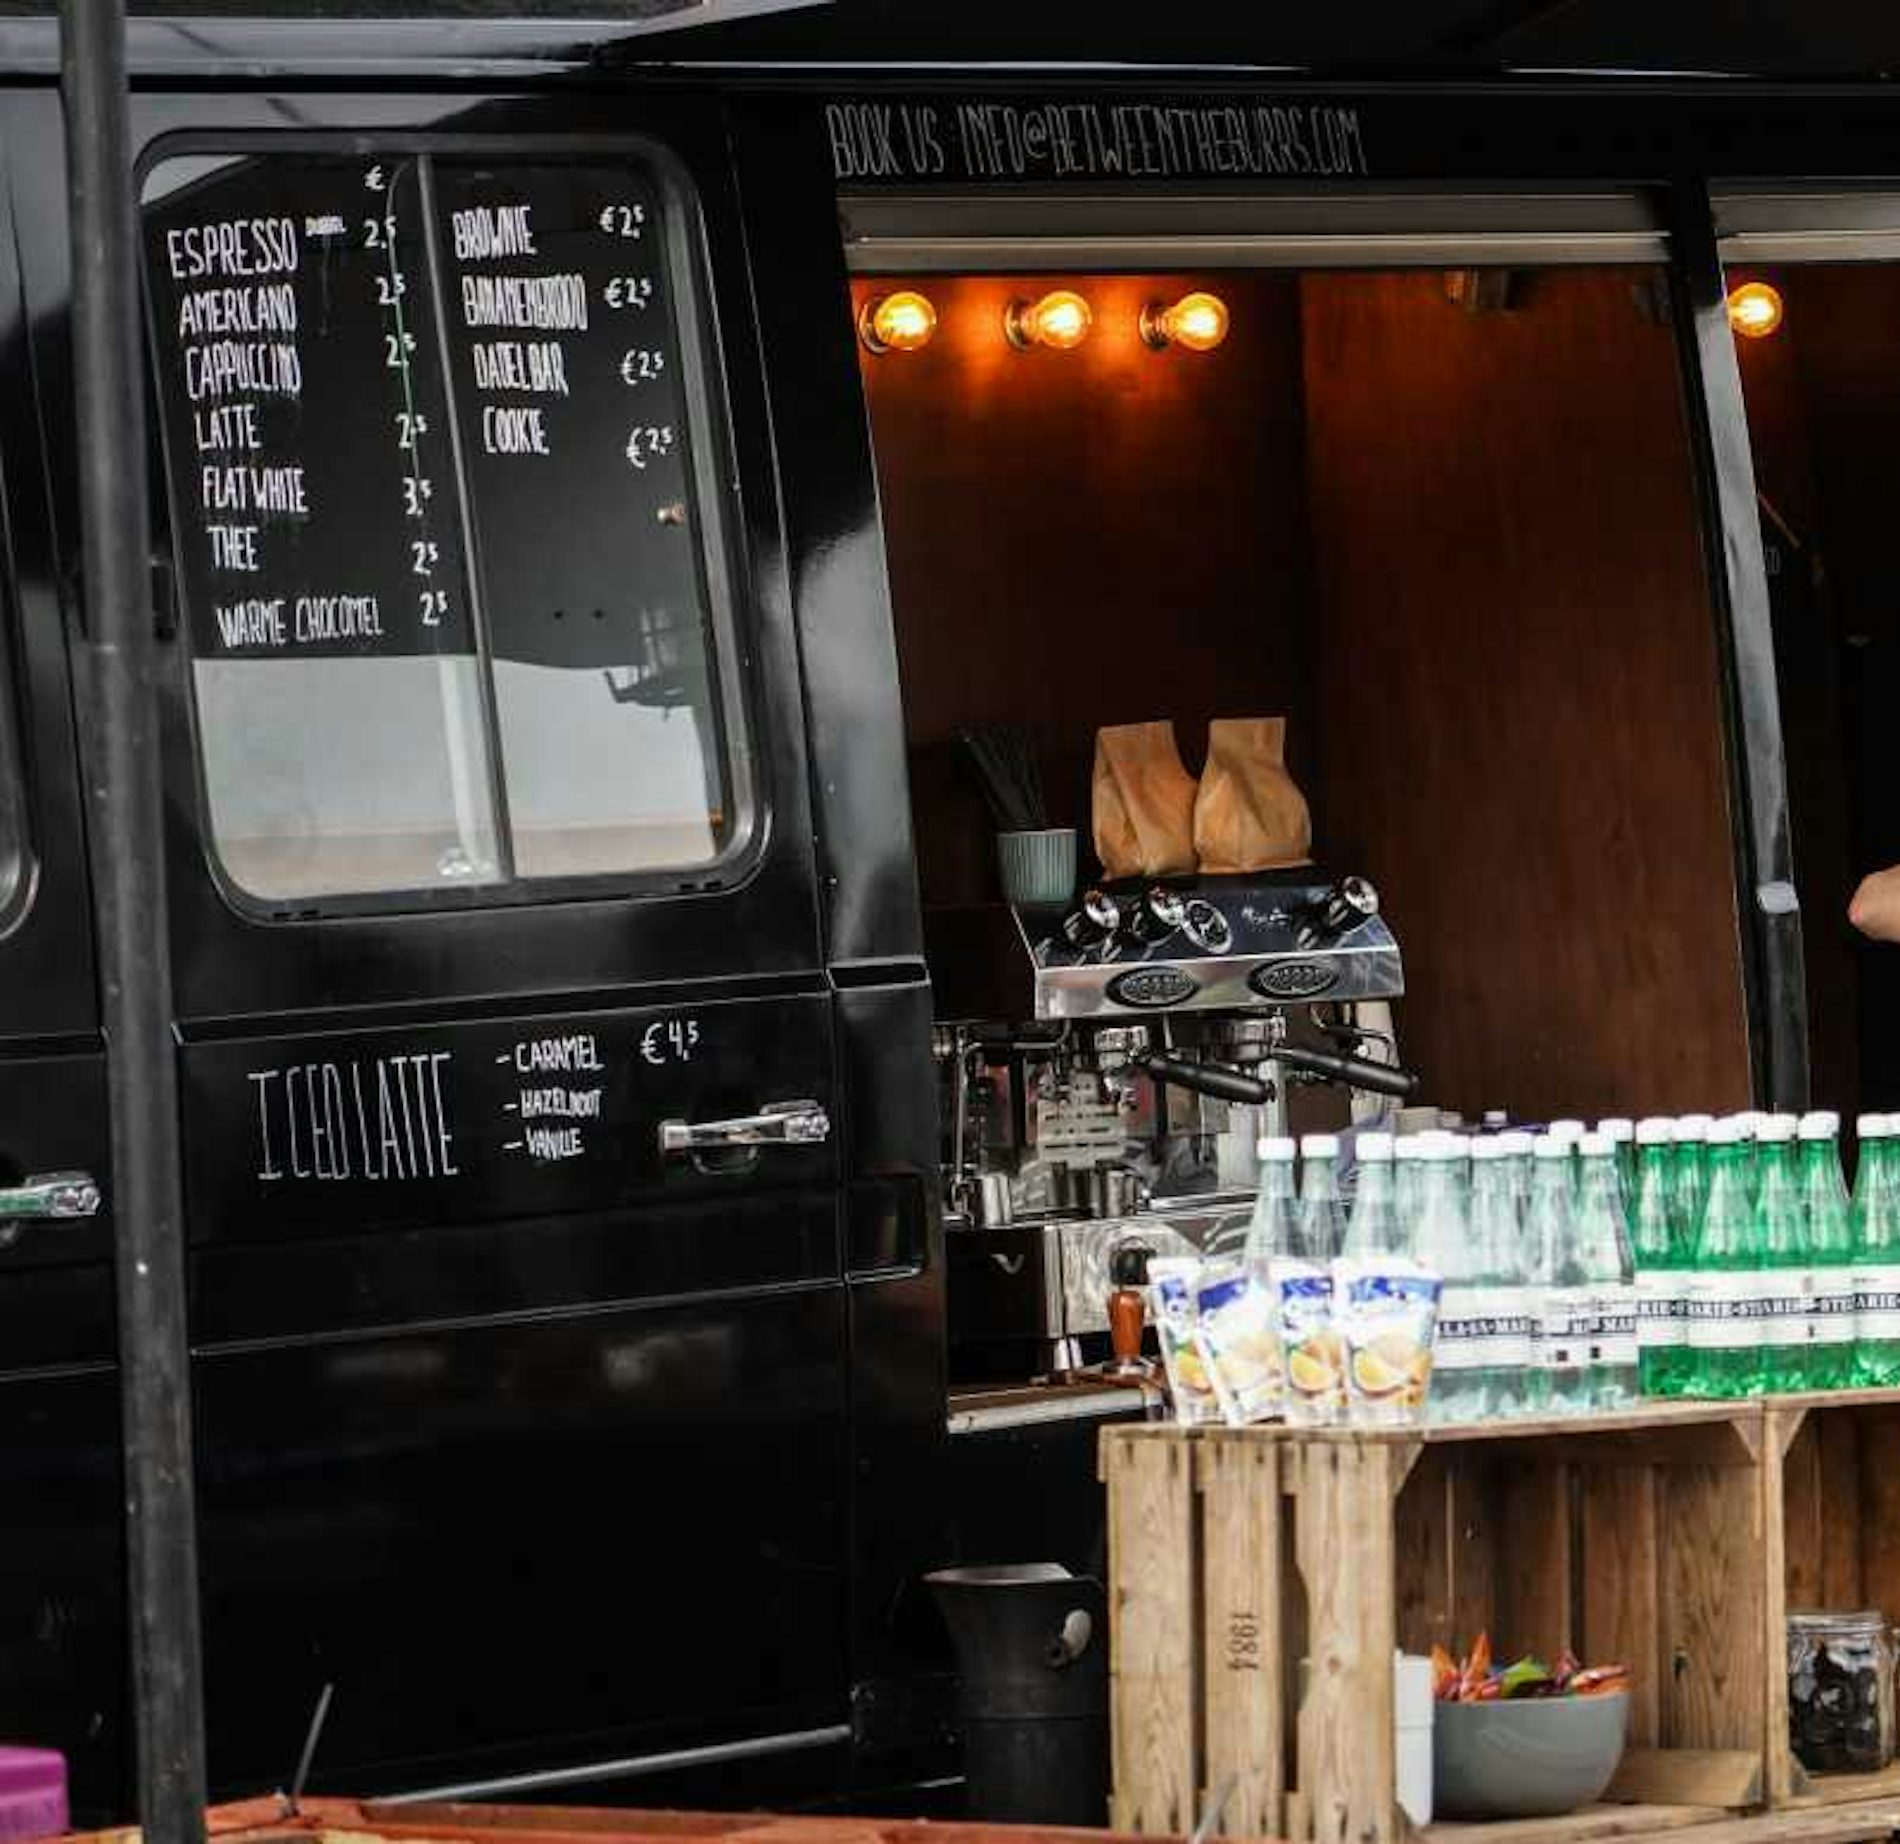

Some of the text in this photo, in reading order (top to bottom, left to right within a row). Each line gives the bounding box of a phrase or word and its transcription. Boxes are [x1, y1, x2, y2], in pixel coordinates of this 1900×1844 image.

[826, 104, 903, 178] BOOK
[902, 106, 944, 172] US
[168, 219, 297, 277] ESPRESSO
[453, 206, 536, 260] BROWNIE
[180, 284, 296, 336] AMERICANO
[186, 340, 301, 400] CAPPUCCINO
[195, 404, 260, 450] LATTE
[484, 406, 549, 454] COOKIE
[203, 466, 249, 513] FLAT
[250, 466, 310, 513] WHITE
[207, 525, 258, 571] THEE
[216, 600, 285, 647] WARME
[296, 596, 383, 641] CHOCOMEL
[1226, 1611, 1259, 1670] 1984
